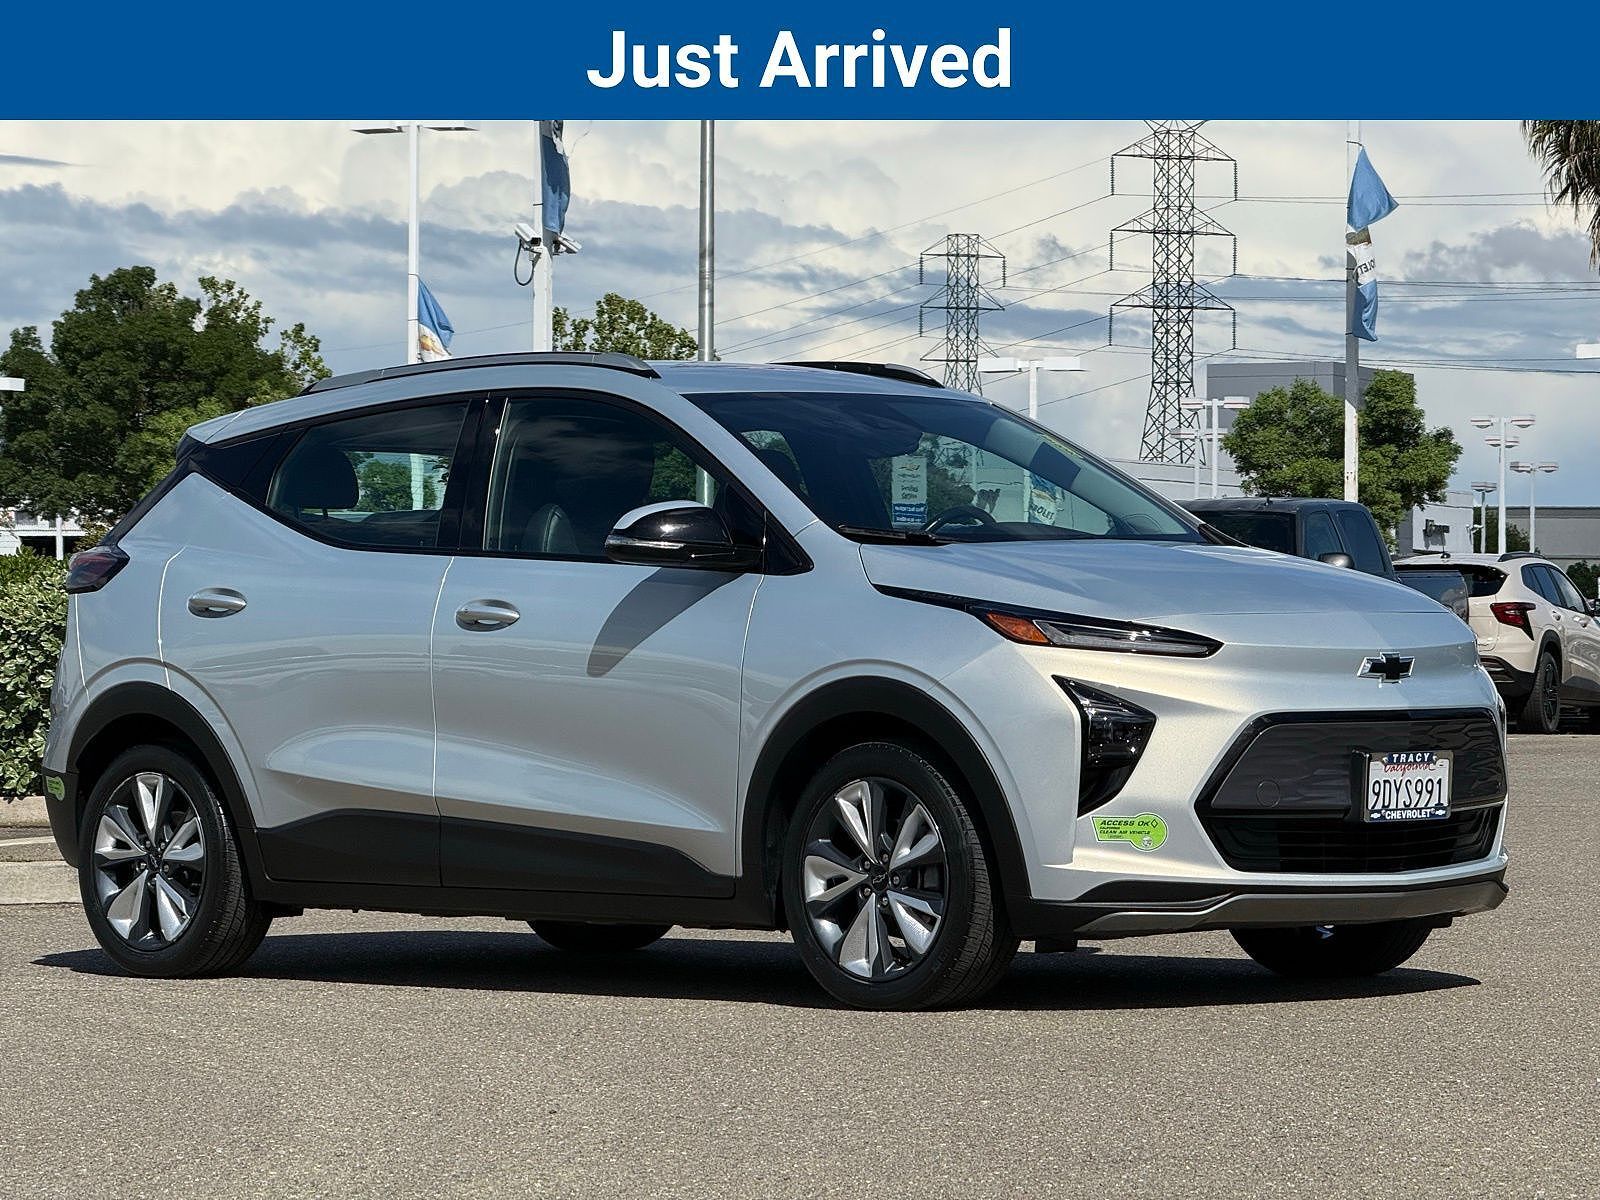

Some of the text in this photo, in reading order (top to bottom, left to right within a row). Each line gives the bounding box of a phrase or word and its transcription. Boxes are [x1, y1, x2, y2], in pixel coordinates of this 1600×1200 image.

[1392, 752, 1430, 763] TRACY
[1371, 778, 1444, 810] 9DYS991
[1385, 809, 1431, 820] CHEVROLET
